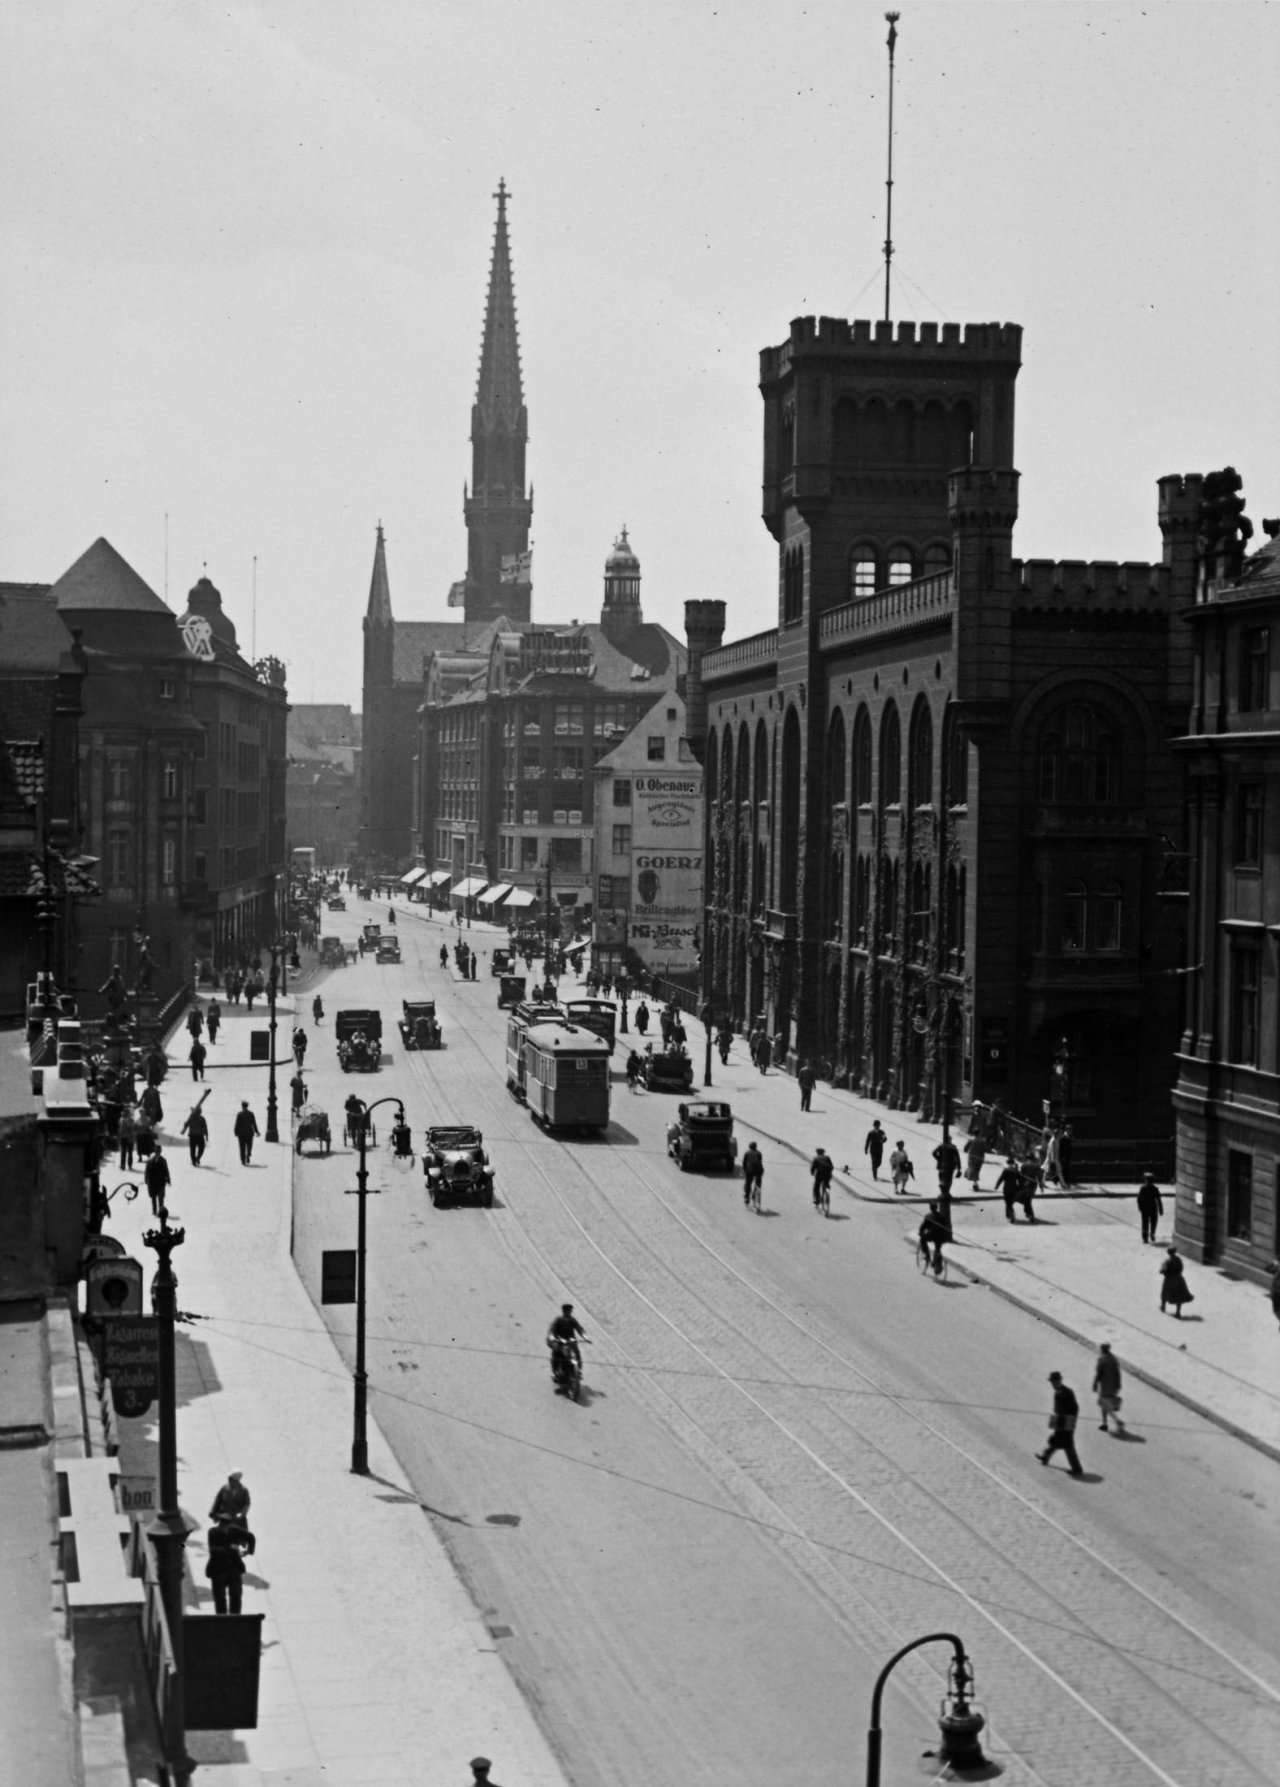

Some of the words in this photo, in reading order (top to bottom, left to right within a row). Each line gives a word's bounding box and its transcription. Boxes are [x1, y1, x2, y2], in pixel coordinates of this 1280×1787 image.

[636, 856, 702, 869] GOERZ
[635, 904, 697, 918] Brillengläse
[105, 1322, 159, 1343] Zigarren
[107, 1367, 155, 1387] Tabake
